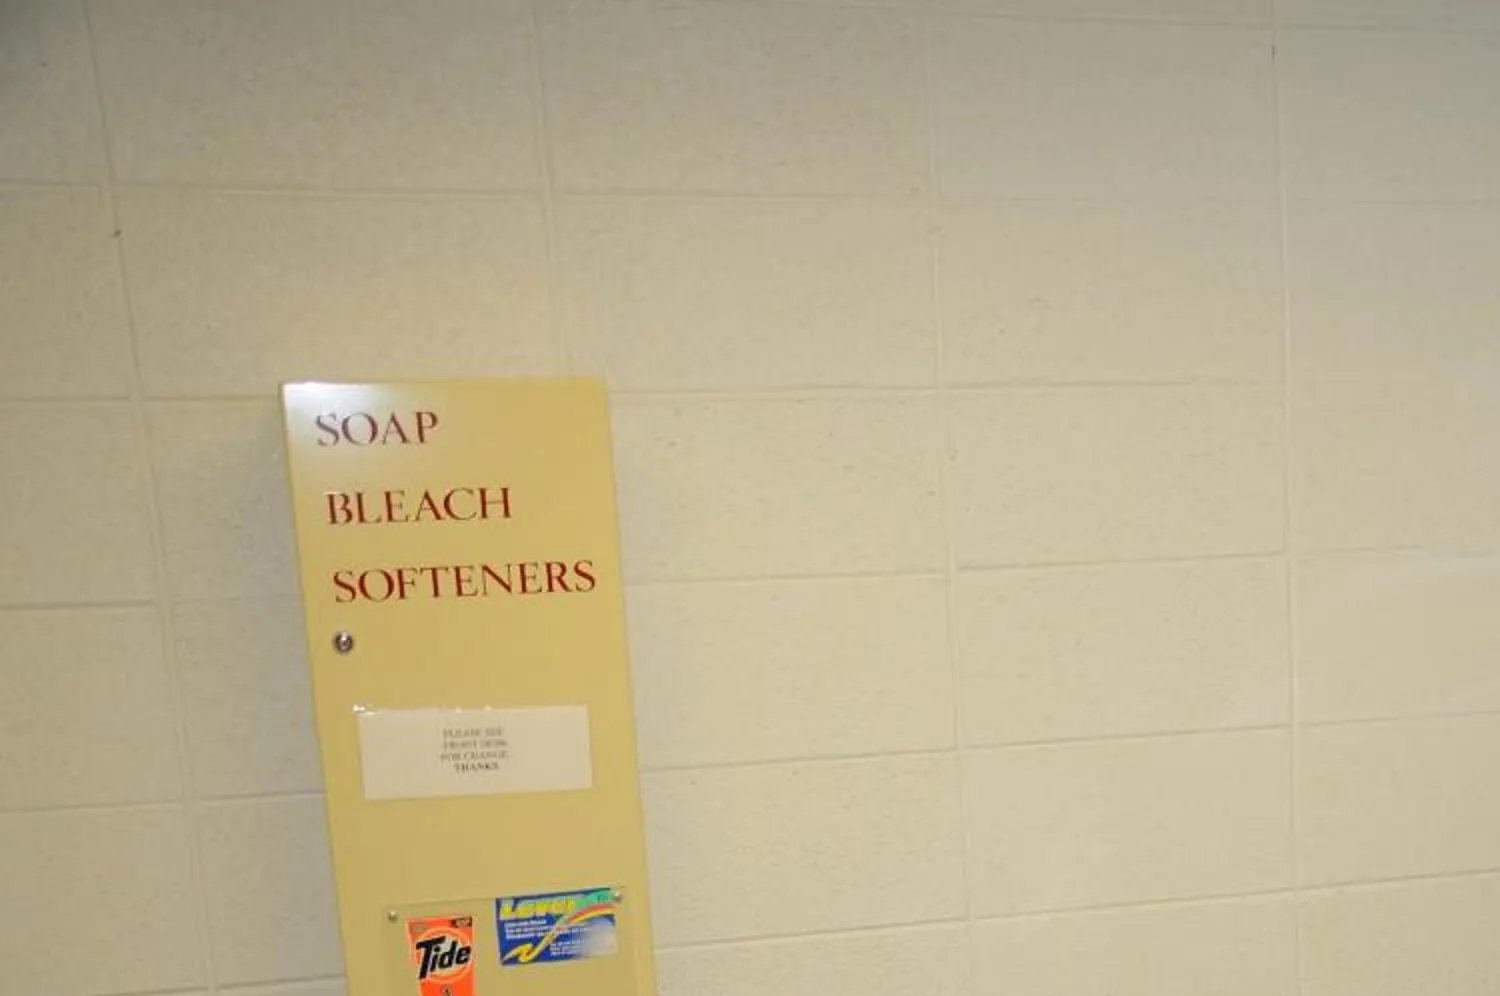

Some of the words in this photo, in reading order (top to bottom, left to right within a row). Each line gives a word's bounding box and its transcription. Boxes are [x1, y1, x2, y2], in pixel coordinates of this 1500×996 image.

[315, 410, 438, 447] SOAP
[326, 487, 513, 525] BLEACH
[333, 560, 597, 603] SOFTENERS
[415, 935, 471, 980] Tide
